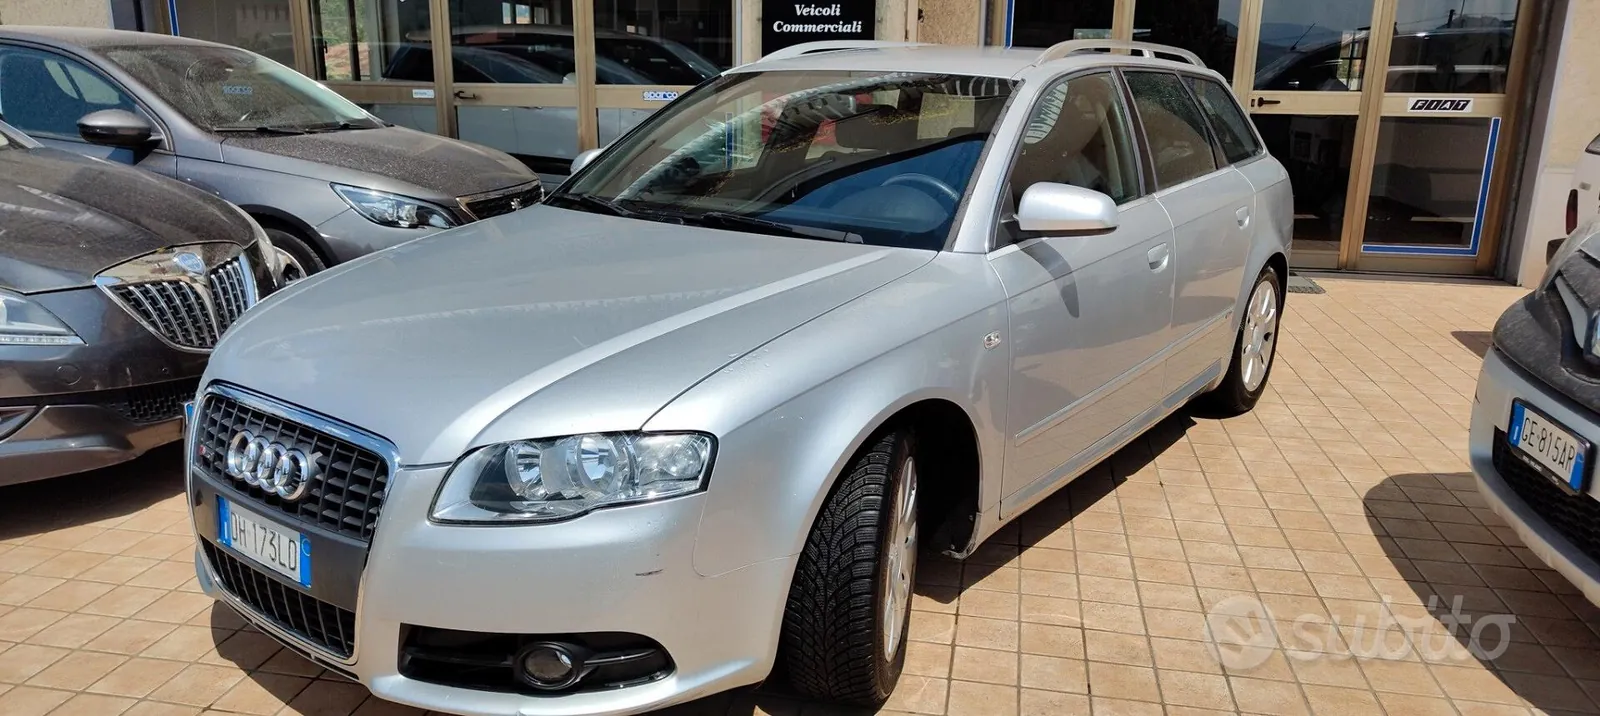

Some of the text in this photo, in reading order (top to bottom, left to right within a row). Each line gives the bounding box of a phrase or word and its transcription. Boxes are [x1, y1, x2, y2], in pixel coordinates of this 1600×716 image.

[794, 4, 841, 16] Veicoli
[773, 21, 862, 33] Commerciali
[1413, 100, 1469, 110] FIAT
